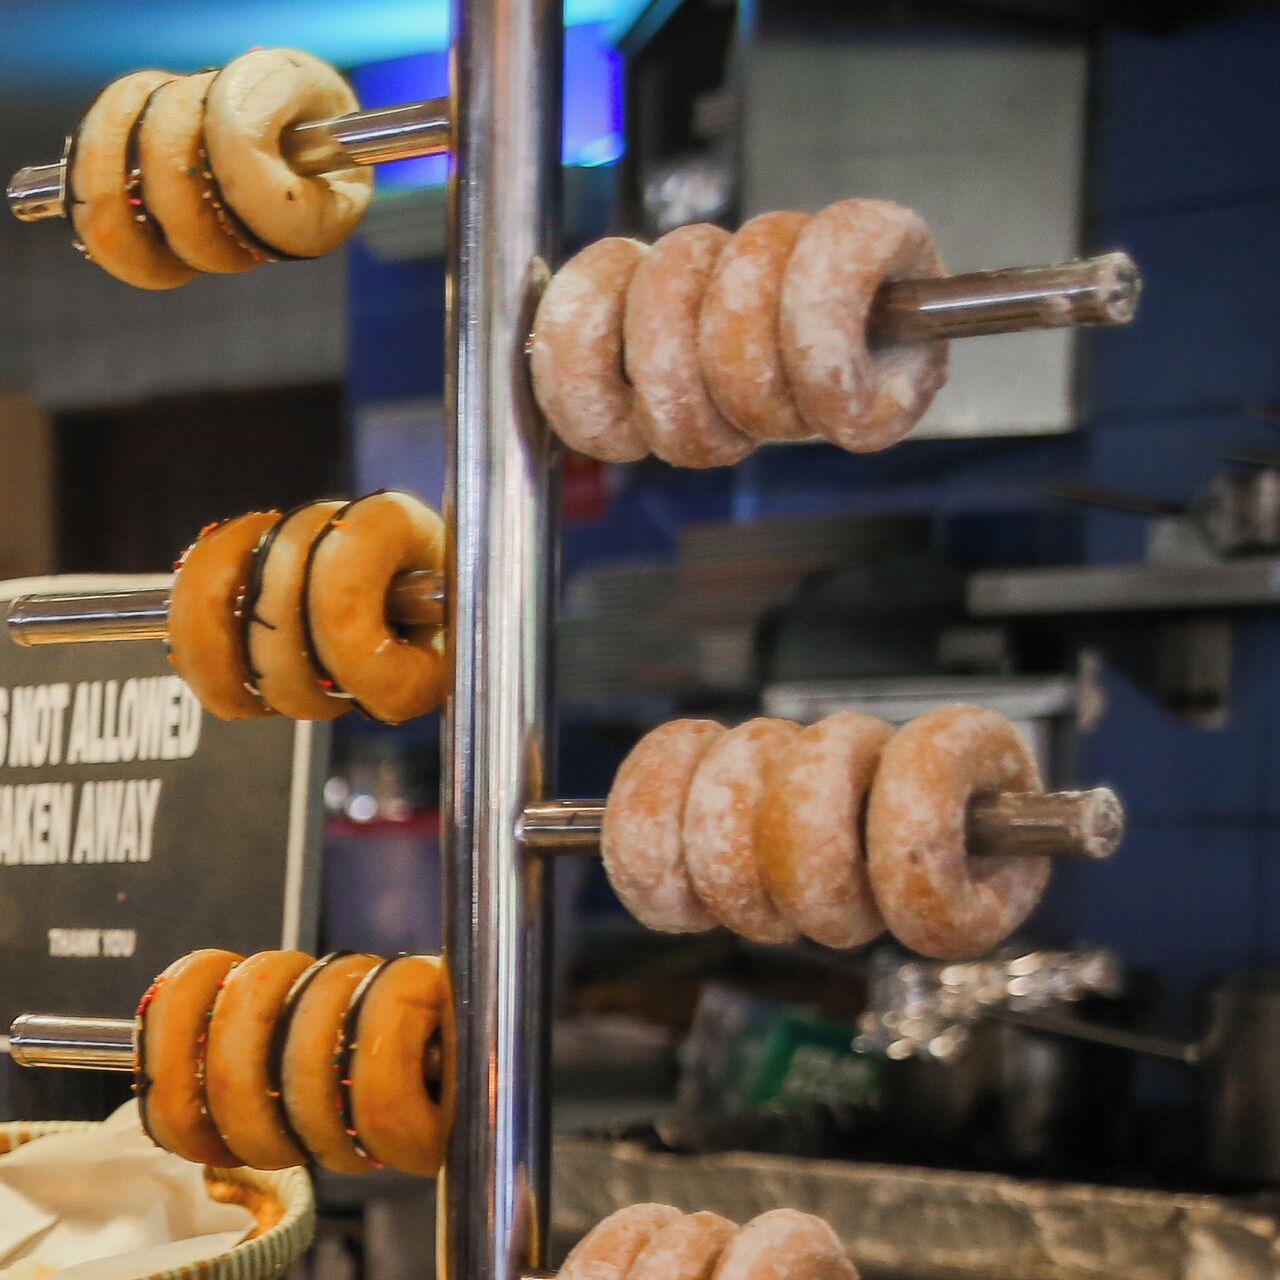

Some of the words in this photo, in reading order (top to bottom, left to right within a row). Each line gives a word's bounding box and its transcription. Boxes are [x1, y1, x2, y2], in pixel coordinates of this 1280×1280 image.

[8, 682, 70, 768] NOT
[66, 674, 203, 765] ALLOWED
[72, 778, 162, 865] AWAY
